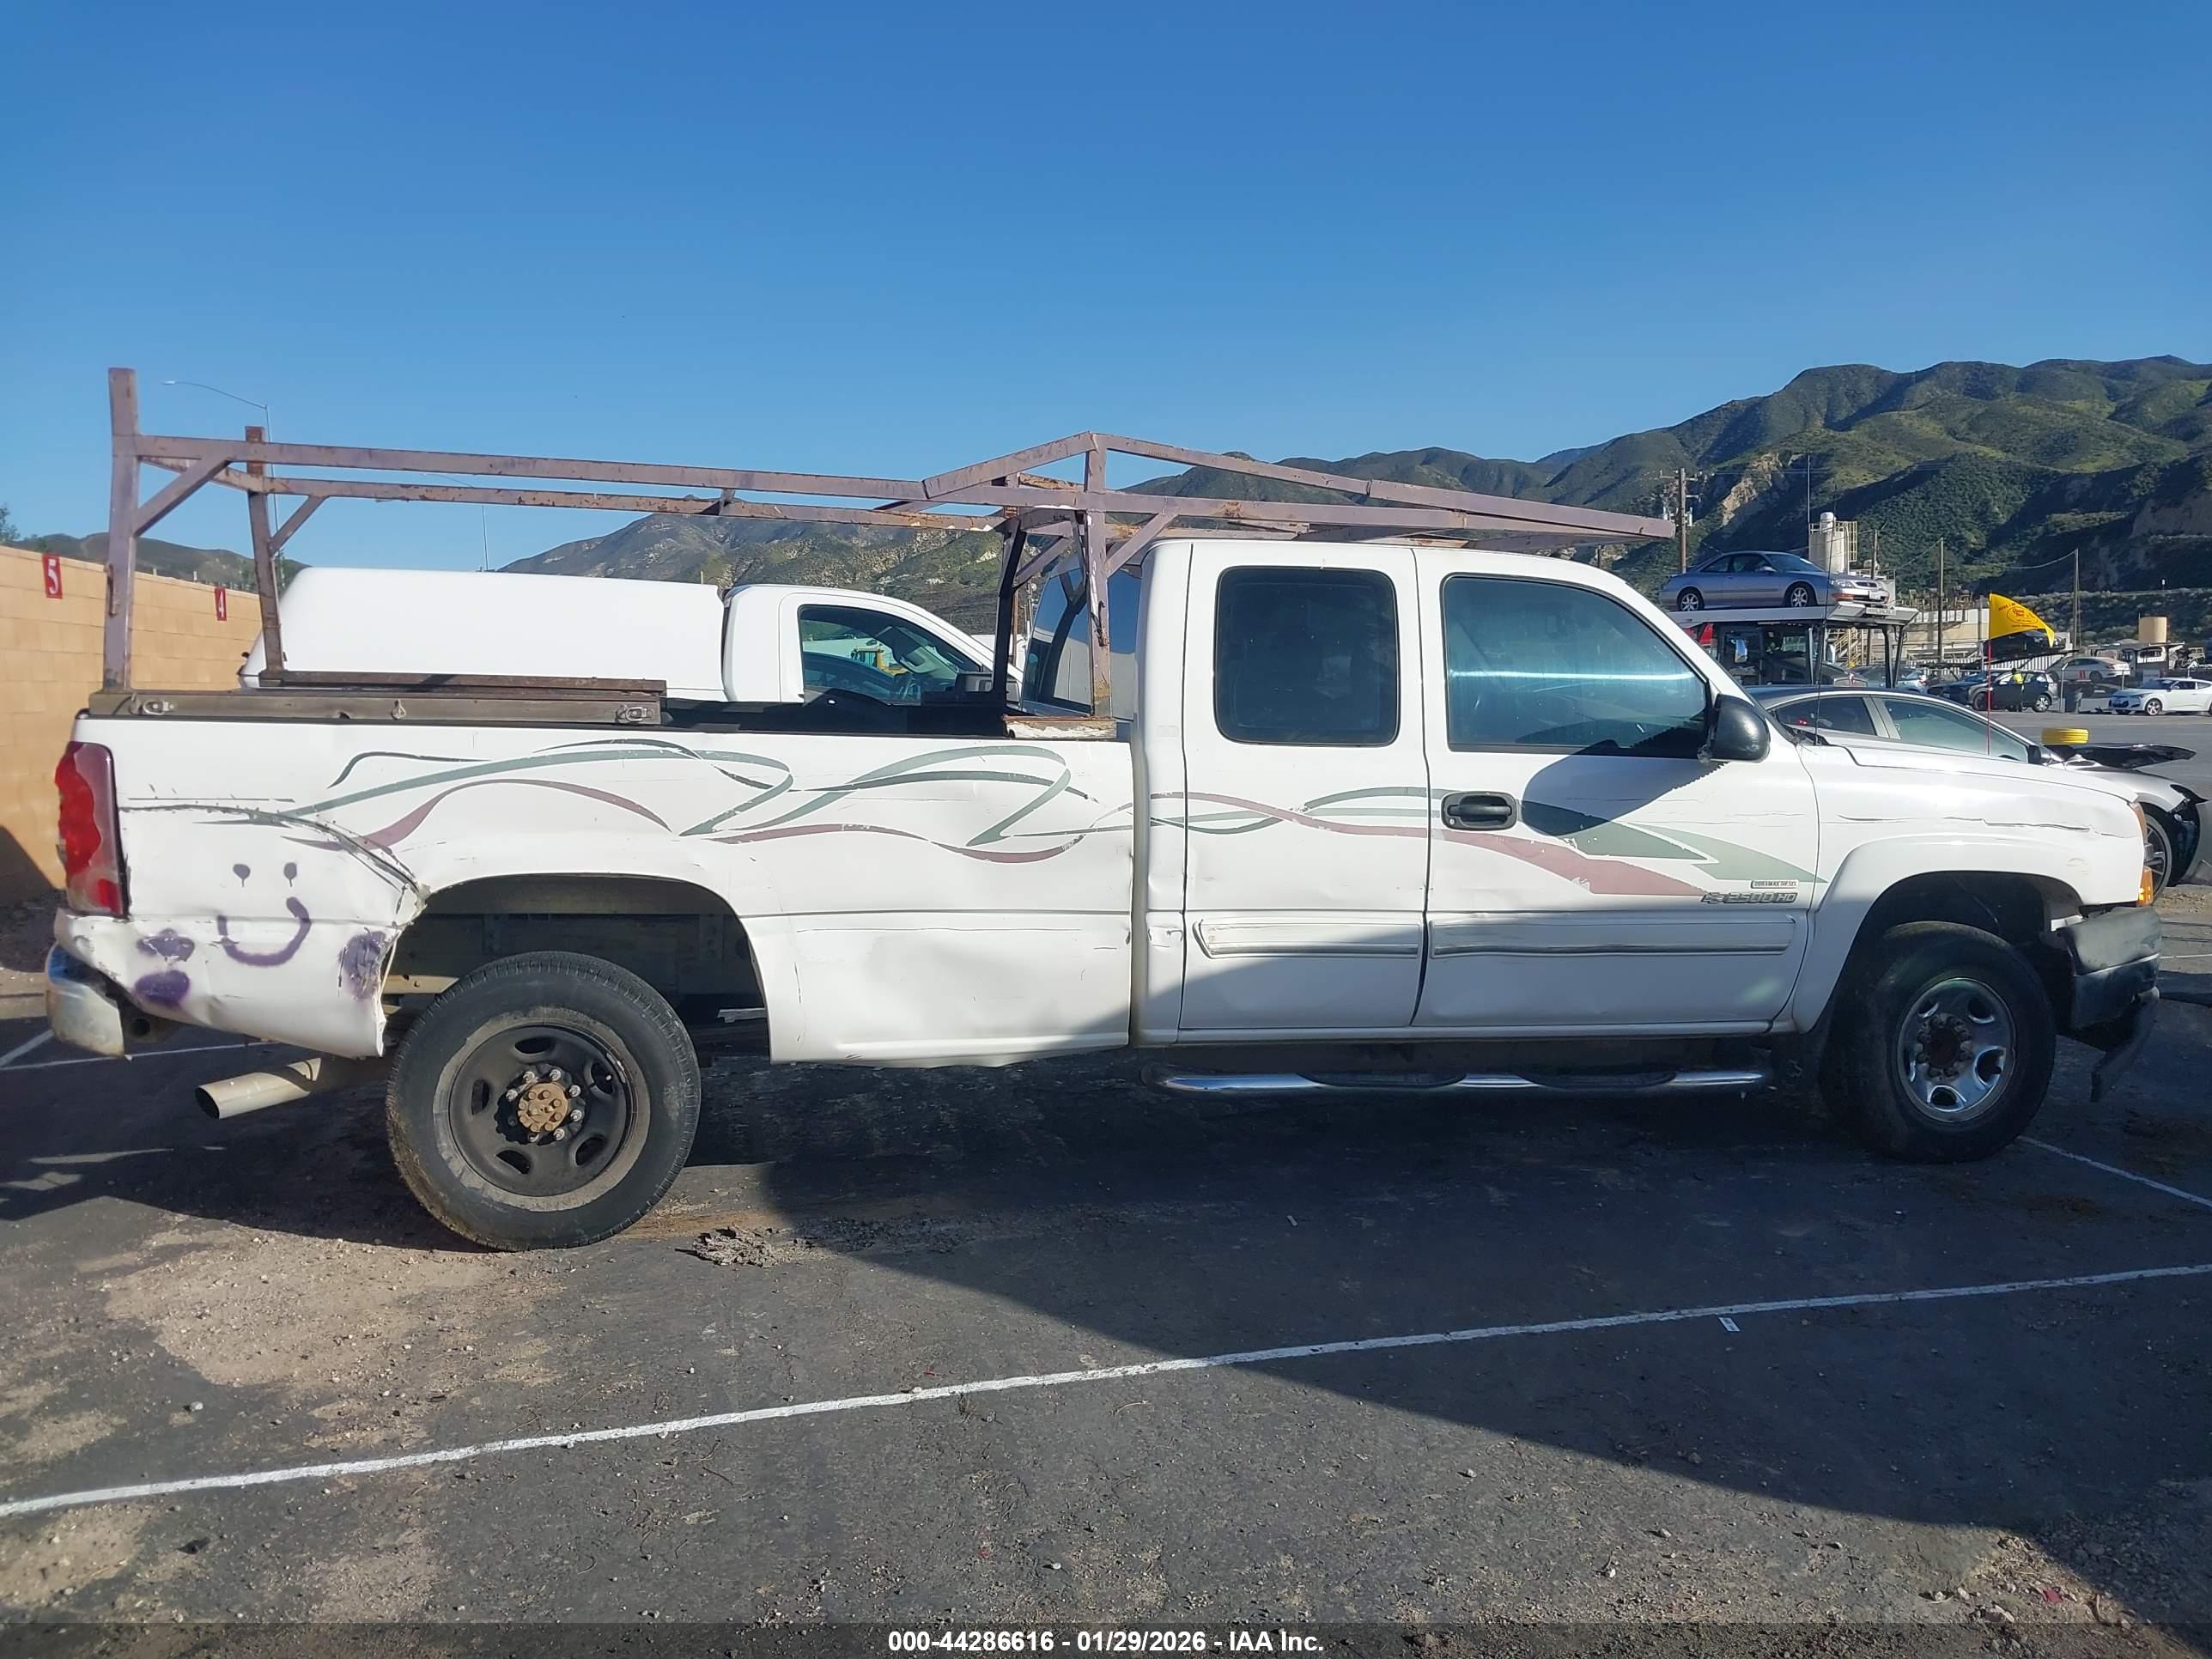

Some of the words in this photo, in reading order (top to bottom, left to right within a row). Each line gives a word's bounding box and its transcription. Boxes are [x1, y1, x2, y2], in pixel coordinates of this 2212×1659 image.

[47, 558, 59, 594] 5
[218, 590, 225, 618] 4
[1724, 892, 1774, 903] 2500
[1774, 892, 1798, 903] HD
